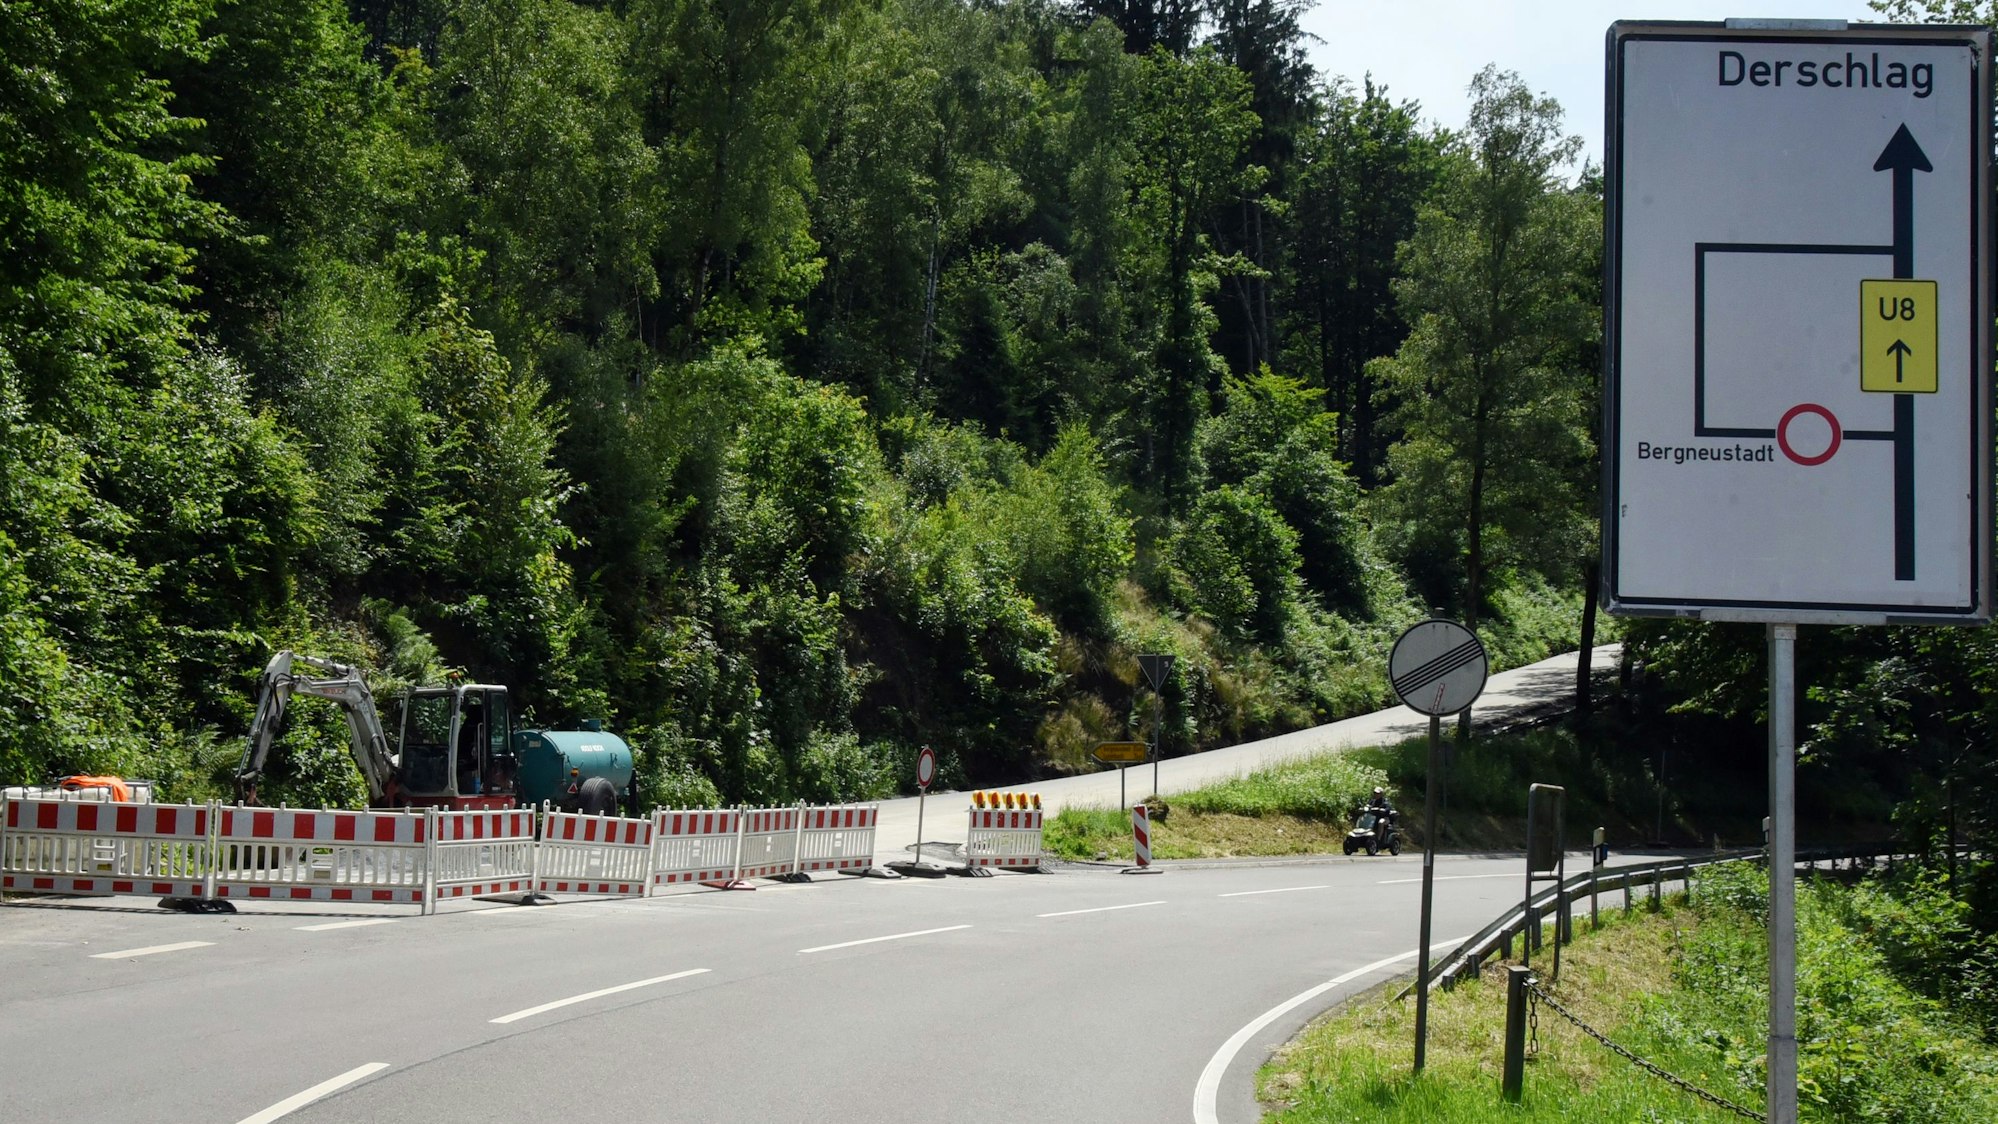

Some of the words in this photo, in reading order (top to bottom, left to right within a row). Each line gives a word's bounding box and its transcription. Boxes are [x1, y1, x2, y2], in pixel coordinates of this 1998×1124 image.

[1718, 50, 1934, 99] Derschlag
[1878, 296, 1916, 322] U8
[1638, 441, 1775, 465] Bergneustadt
